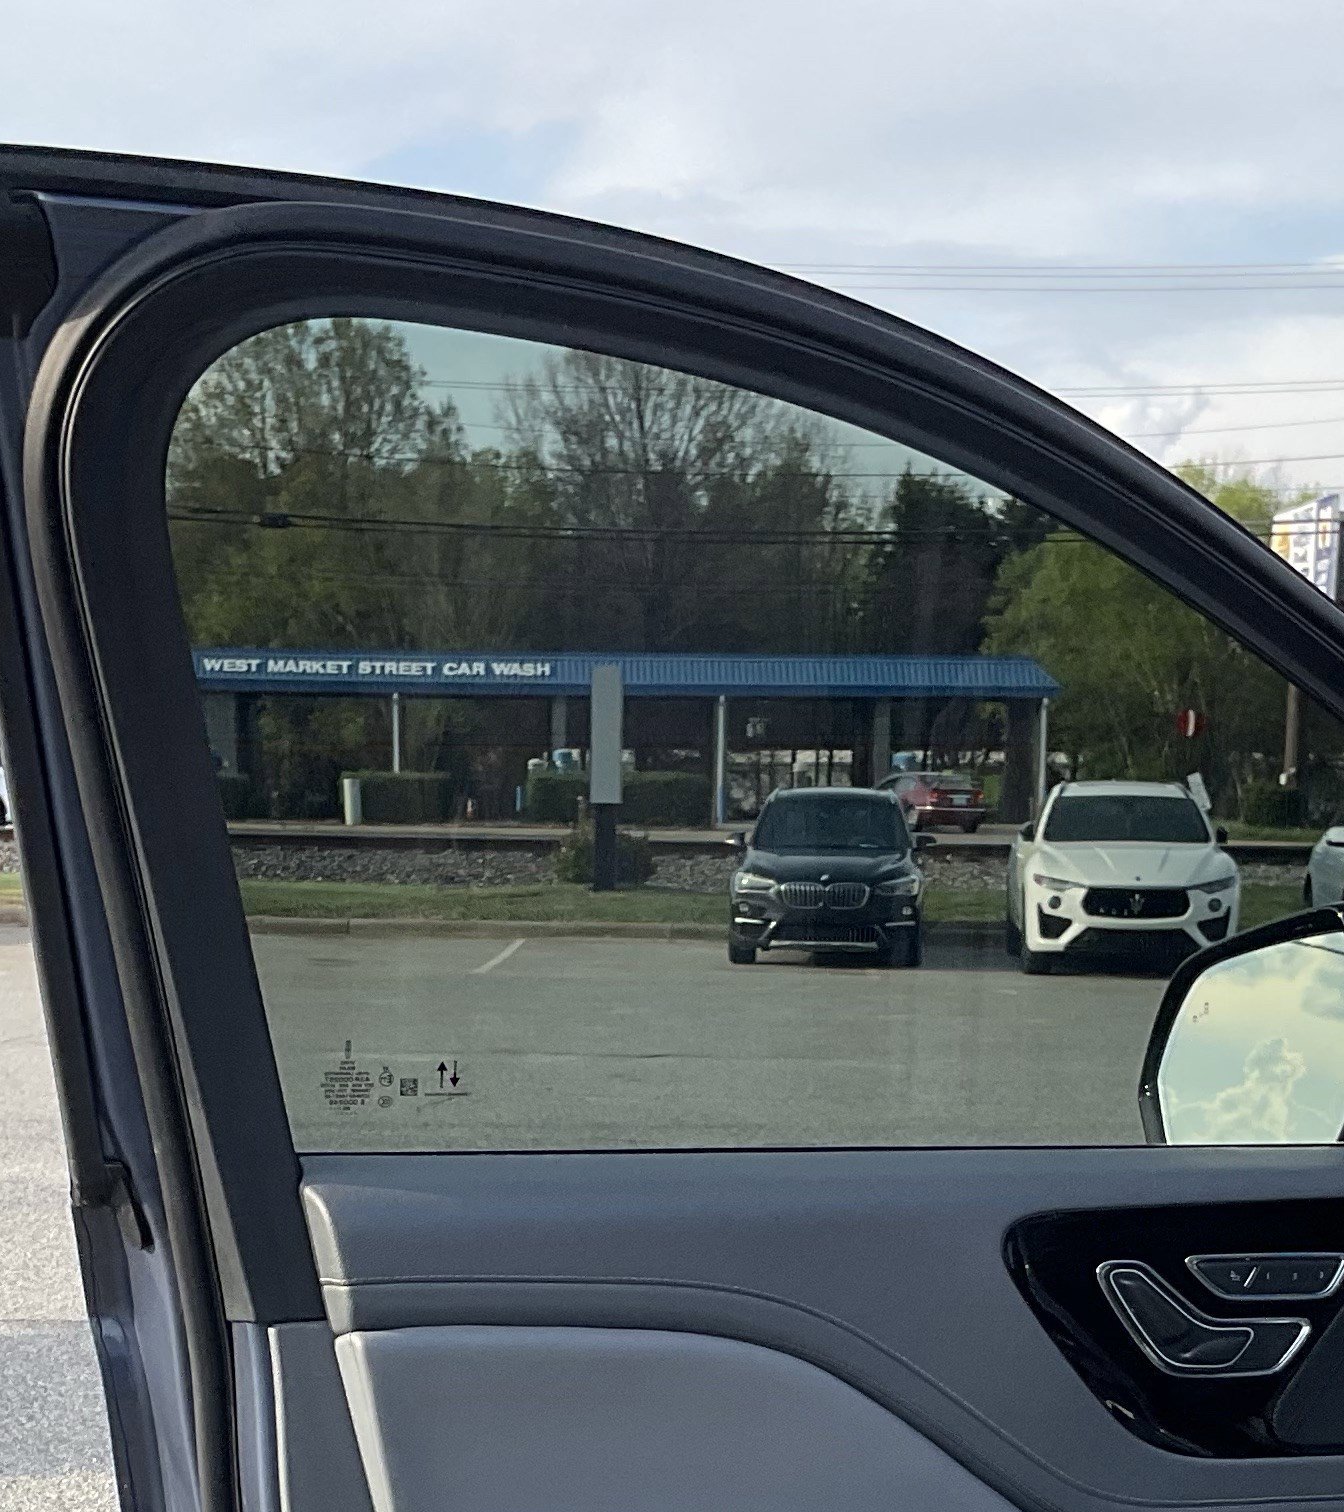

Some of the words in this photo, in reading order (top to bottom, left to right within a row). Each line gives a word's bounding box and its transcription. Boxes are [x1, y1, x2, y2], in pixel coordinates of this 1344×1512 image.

[202, 657, 261, 673] WEST
[267, 658, 353, 674] MARKET
[358, 660, 436, 676] STREET
[442, 661, 486, 677] CAR
[491, 661, 552, 678] WASH
